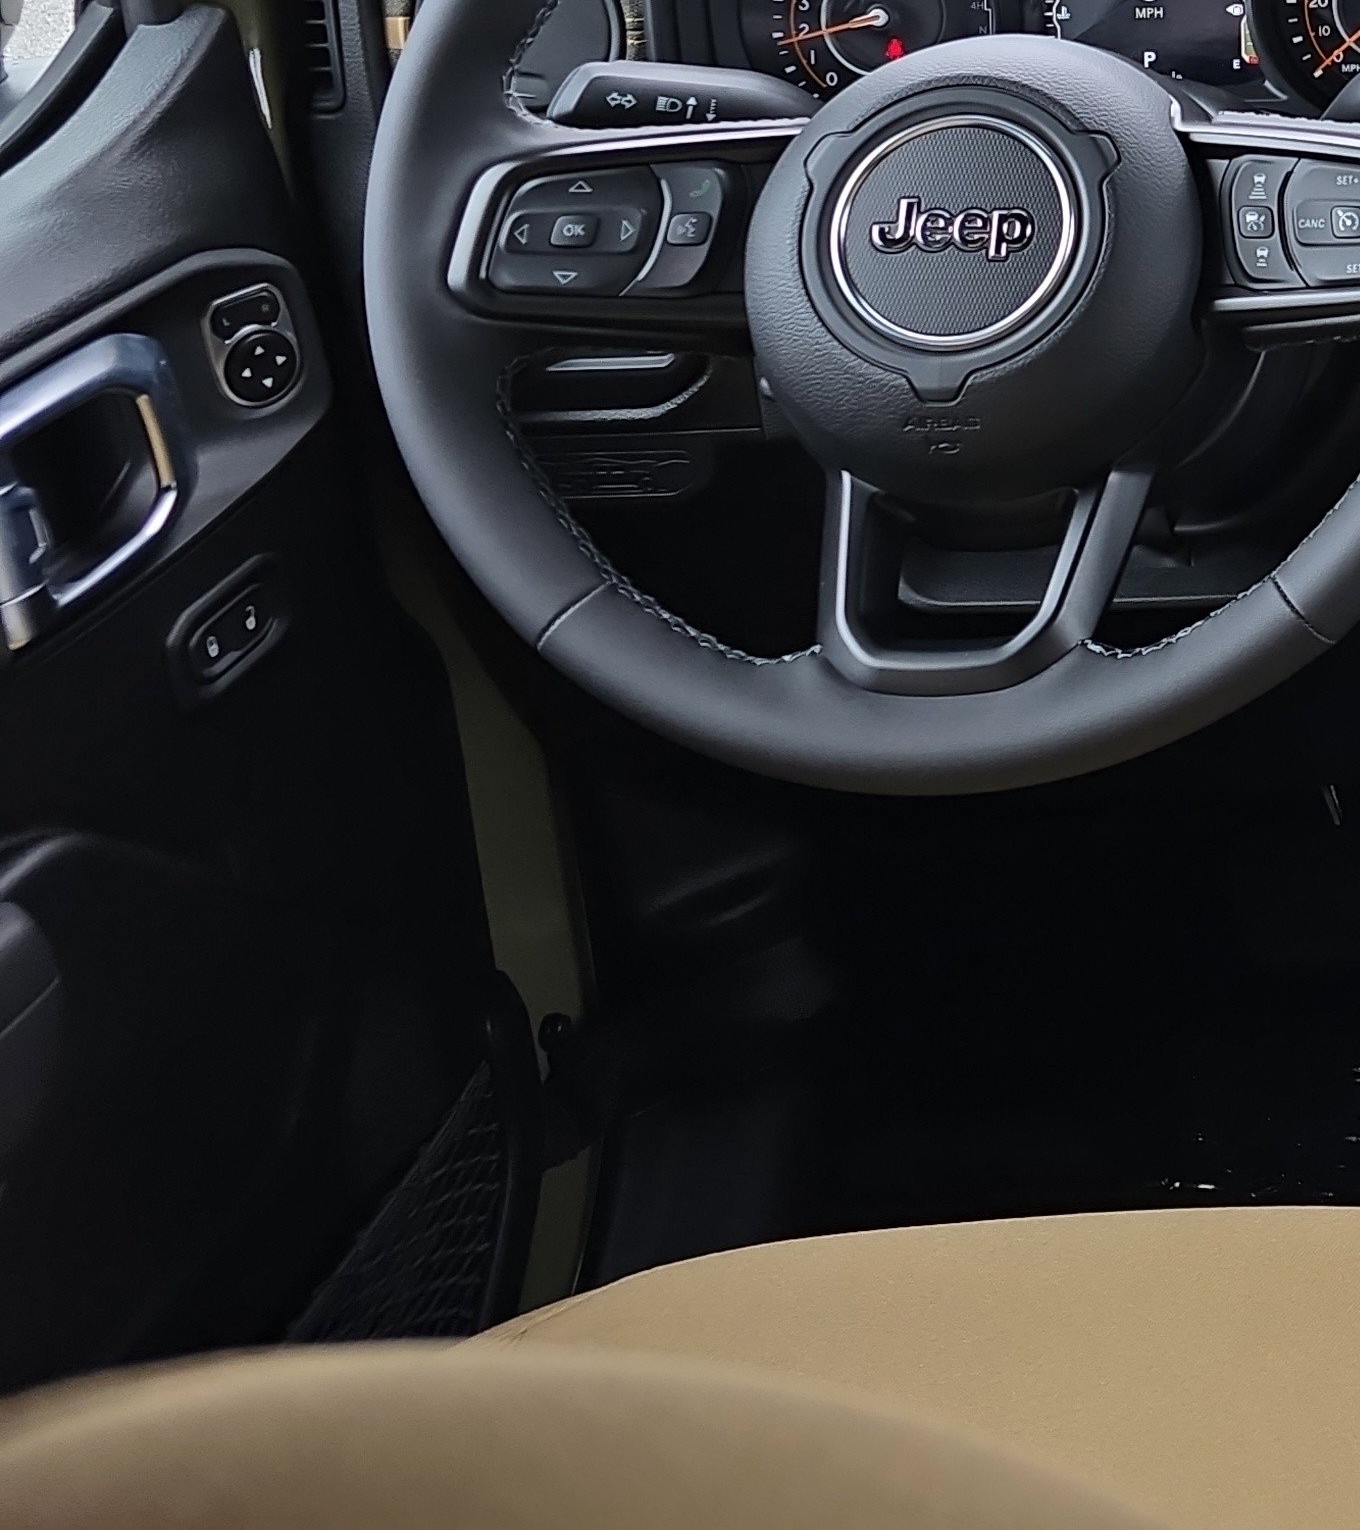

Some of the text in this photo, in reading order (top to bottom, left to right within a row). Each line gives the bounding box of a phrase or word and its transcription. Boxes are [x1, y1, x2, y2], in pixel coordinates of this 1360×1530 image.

[1135, 7, 1164, 19] MPH
[1318, 25, 1331, 37] 10
[1143, 51, 1157, 69] P
[1333, 50, 1344, 63] 0
[1232, 59, 1242, 70] E
[825, 71, 838, 87] 0
[562, 222, 586, 237] OK
[870, 195, 1036, 261] Jeep
[1298, 218, 1326, 230] CANC
